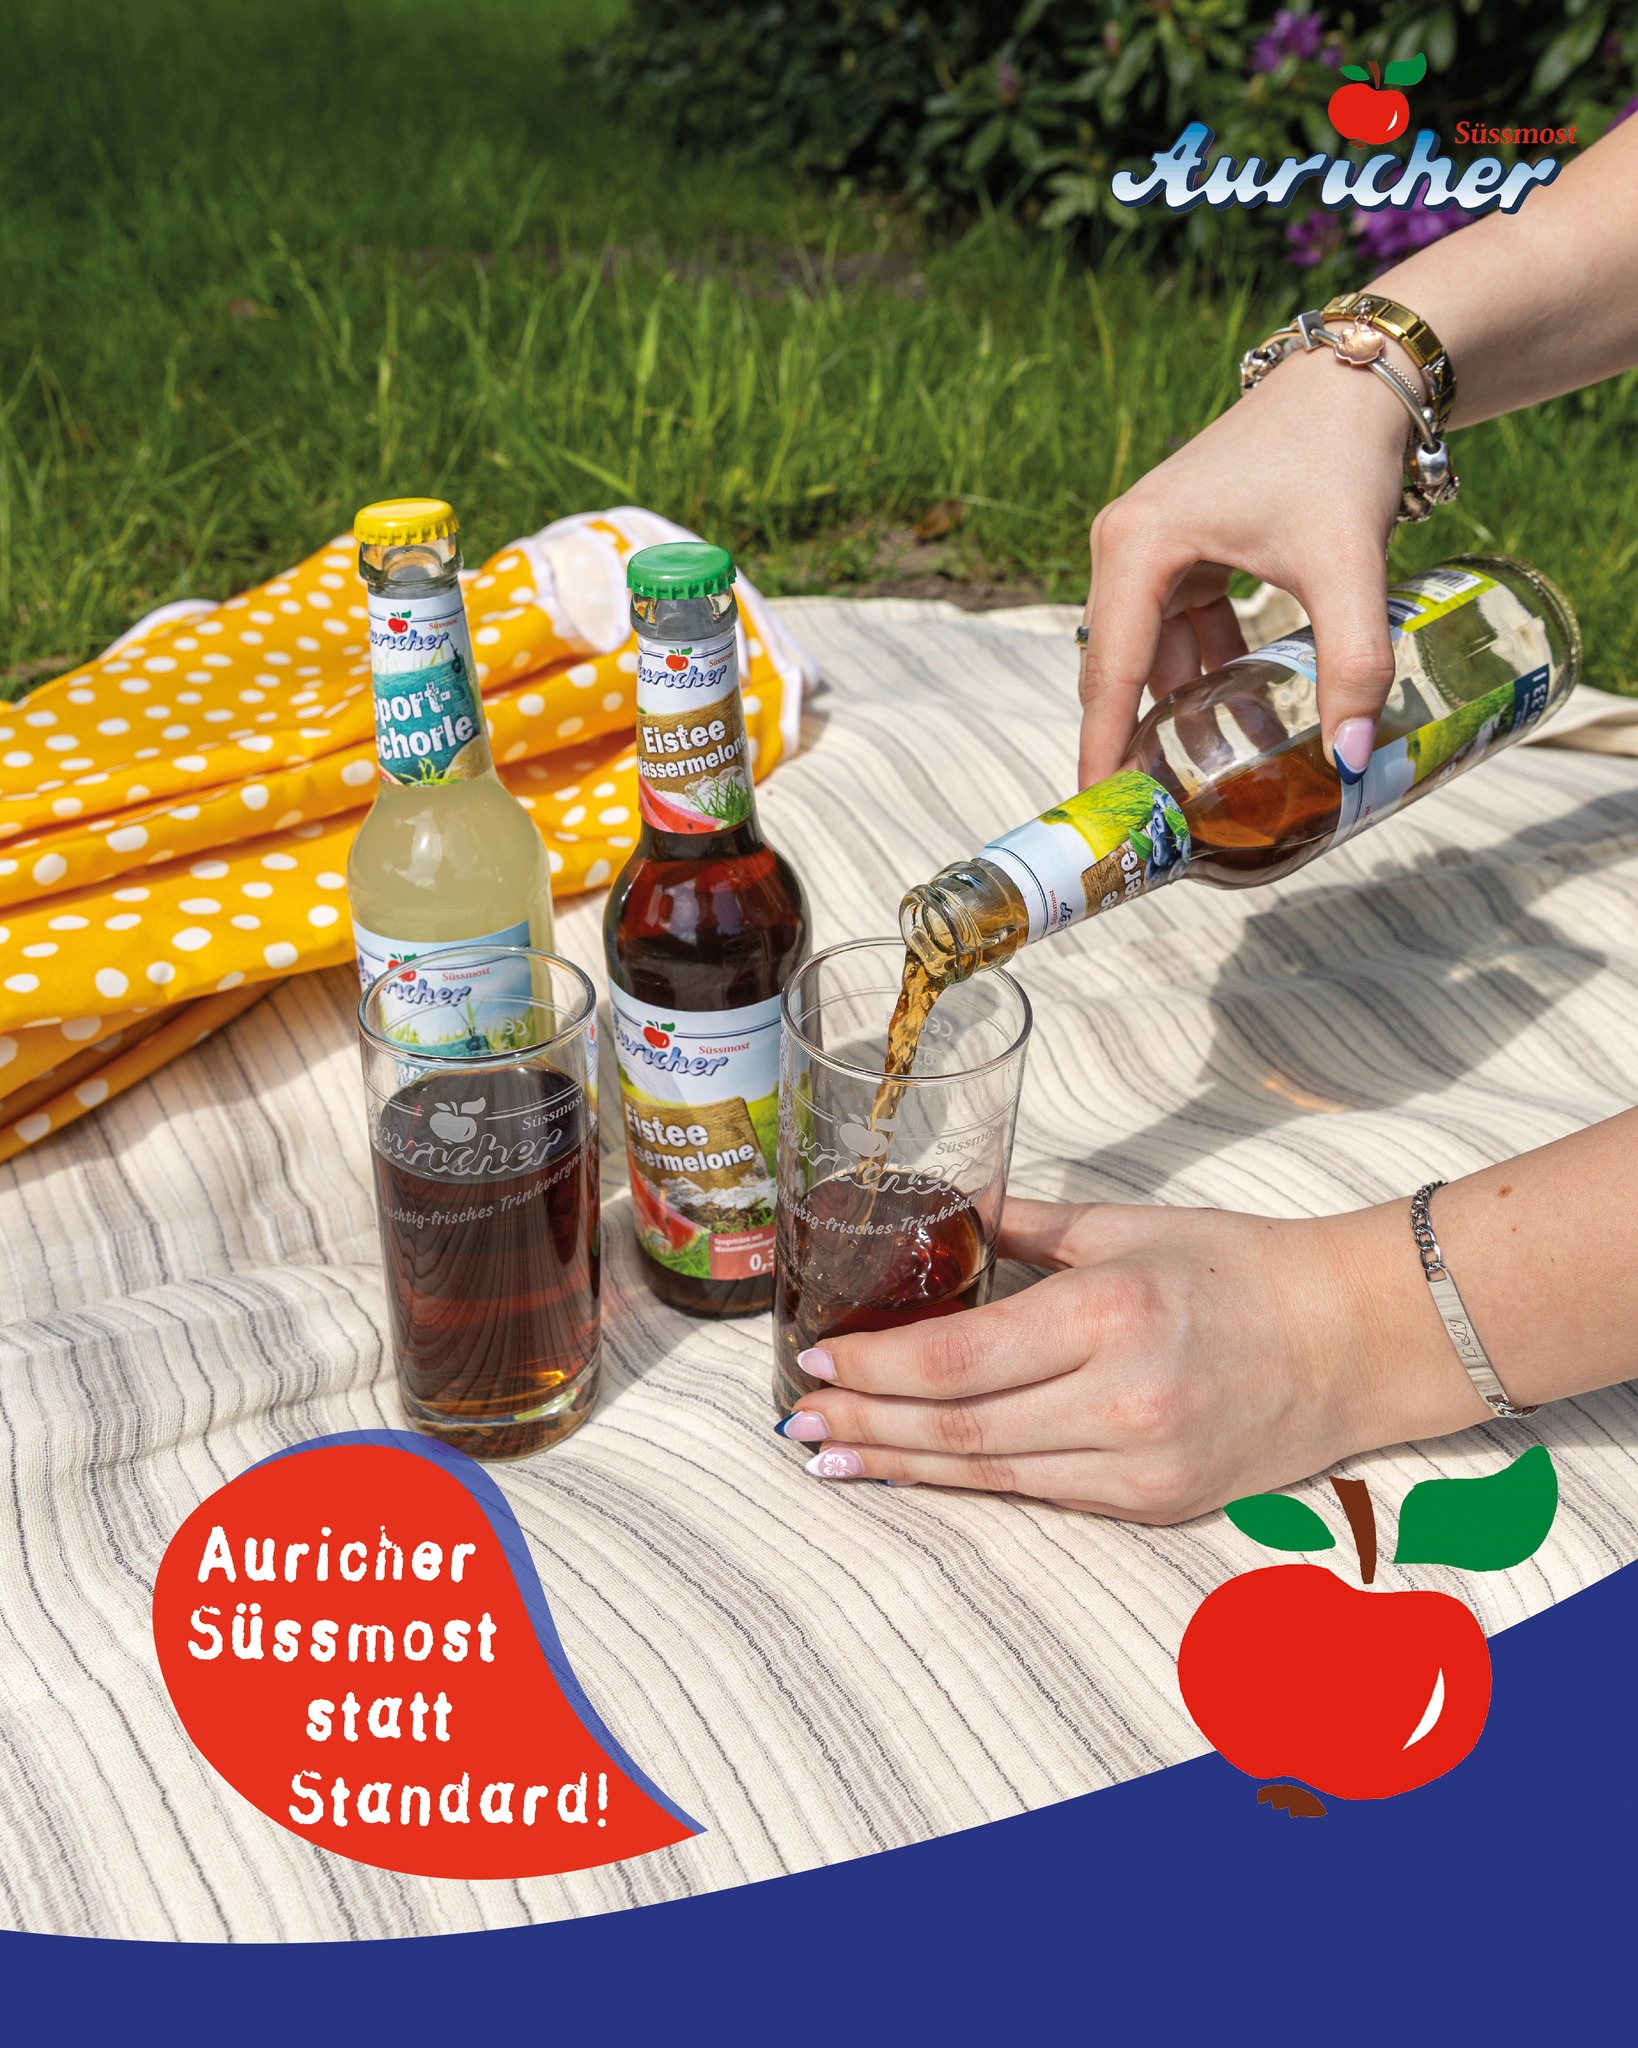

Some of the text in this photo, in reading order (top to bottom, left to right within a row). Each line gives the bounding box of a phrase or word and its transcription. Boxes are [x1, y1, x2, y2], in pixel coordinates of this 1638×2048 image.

[369, 629, 450, 651] uricher
[642, 720, 725, 754] Eistee
[441, 967, 490, 982] Süssmost
[699, 1041, 750, 1055] Süssmost
[625, 1102, 709, 1148] Eistee
